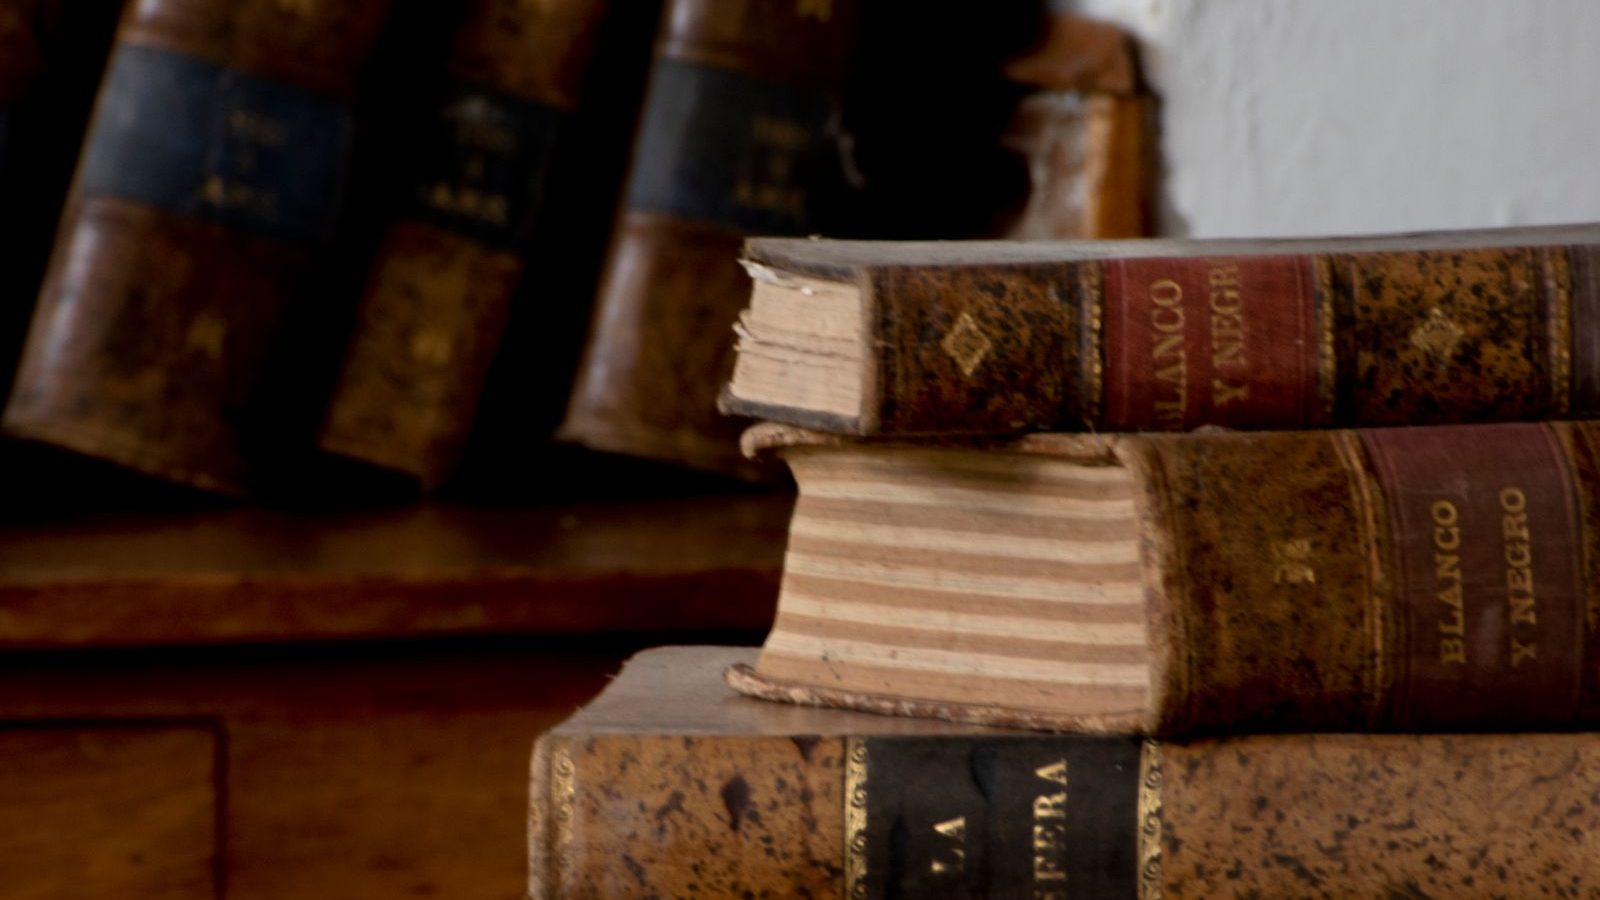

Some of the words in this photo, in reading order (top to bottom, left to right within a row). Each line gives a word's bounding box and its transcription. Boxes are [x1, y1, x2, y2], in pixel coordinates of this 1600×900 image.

[1209, 255, 1247, 367] NEGR
[1210, 379, 1248, 408] Y
[1431, 500, 1465, 665] BLANCO
[1501, 486, 1537, 625] NEGRO
[1511, 640, 1537, 667] Y
[931, 816, 966, 874] LA
